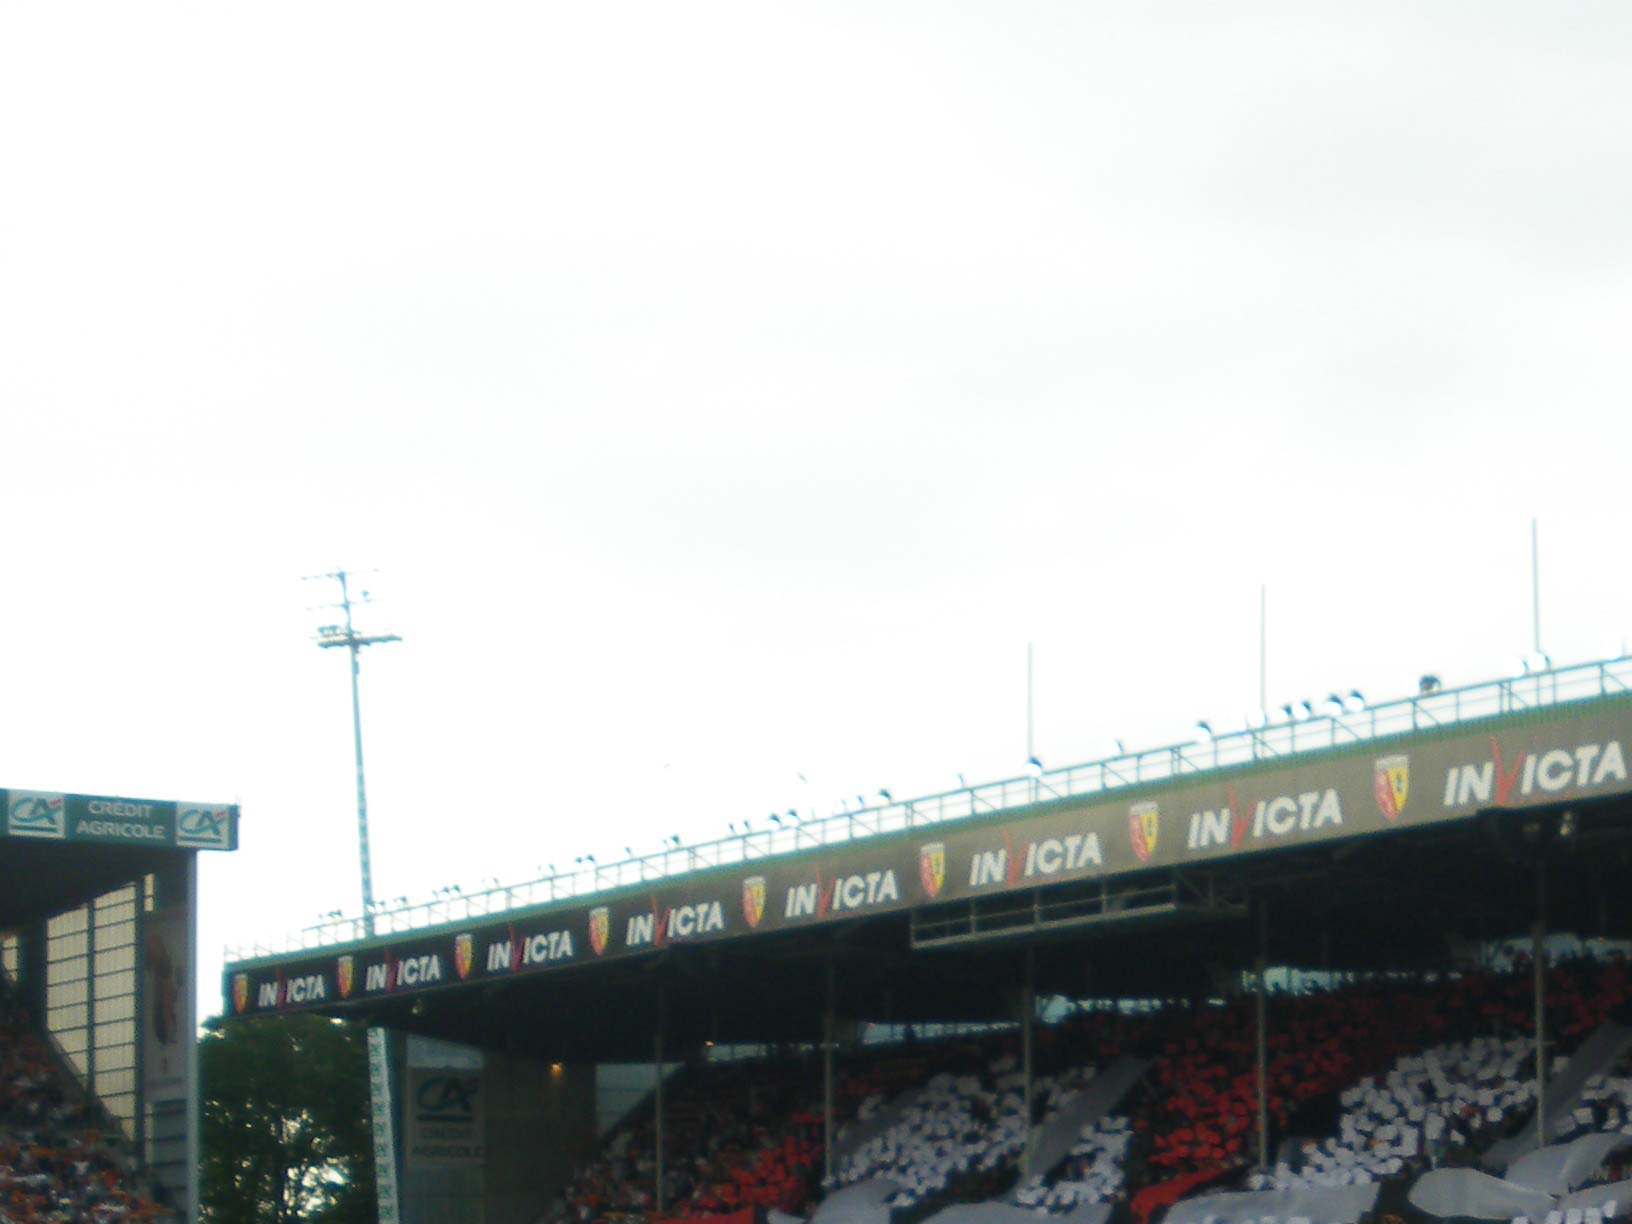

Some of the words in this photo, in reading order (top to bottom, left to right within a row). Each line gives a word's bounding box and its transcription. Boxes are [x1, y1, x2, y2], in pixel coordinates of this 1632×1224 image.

[1443, 736, 1628, 807] INVICTA
[76, 819, 166, 839] AGRICOLE
[1187, 784, 1343, 850] INVICTA
[970, 828, 1101, 887] INVICTA
[784, 862, 899, 919] INVICTA
[487, 922, 573, 972] INVICTA
[626, 895, 725, 948] INVICTA
[258, 966, 325, 1009] INVICTA
[366, 947, 442, 993] INVICTA
